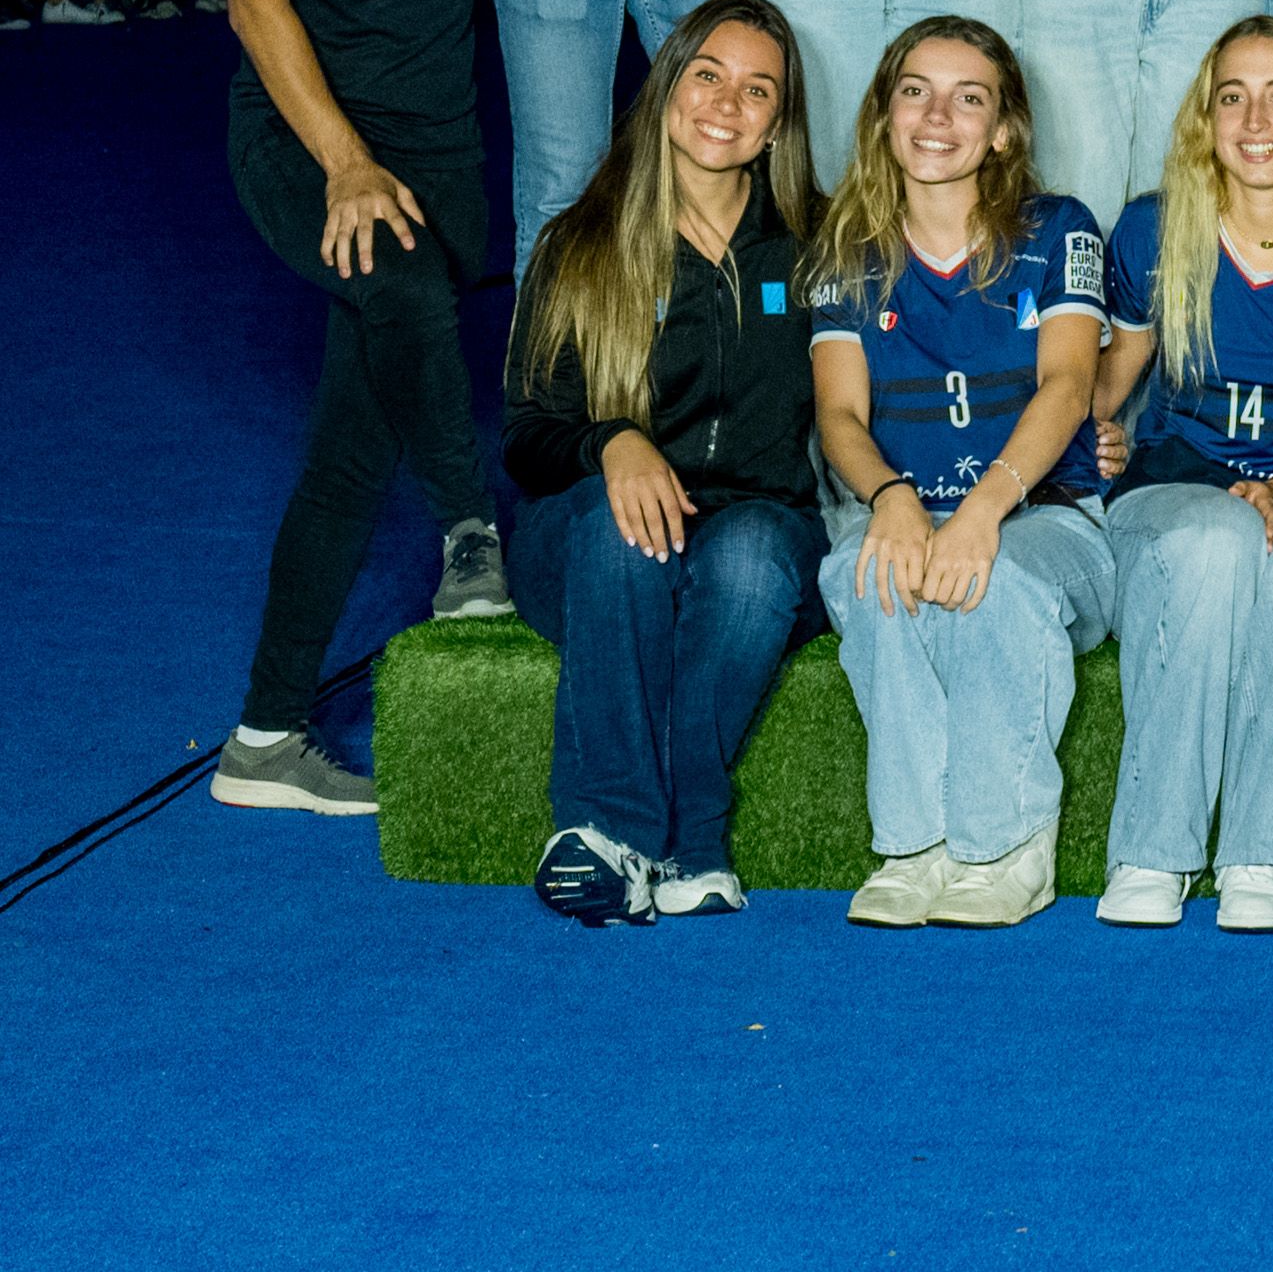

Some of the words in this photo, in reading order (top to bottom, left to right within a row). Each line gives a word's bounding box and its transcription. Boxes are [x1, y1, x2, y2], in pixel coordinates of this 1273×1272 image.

[1071, 235, 1102, 260] EHL
[1071, 252, 1097, 268] EURO
[1071, 265, 1103, 282] HOCKE
[1071, 277, 1102, 297] LEAGU
[946, 370, 971, 429] 3
[1226, 381, 1265, 441] 14
